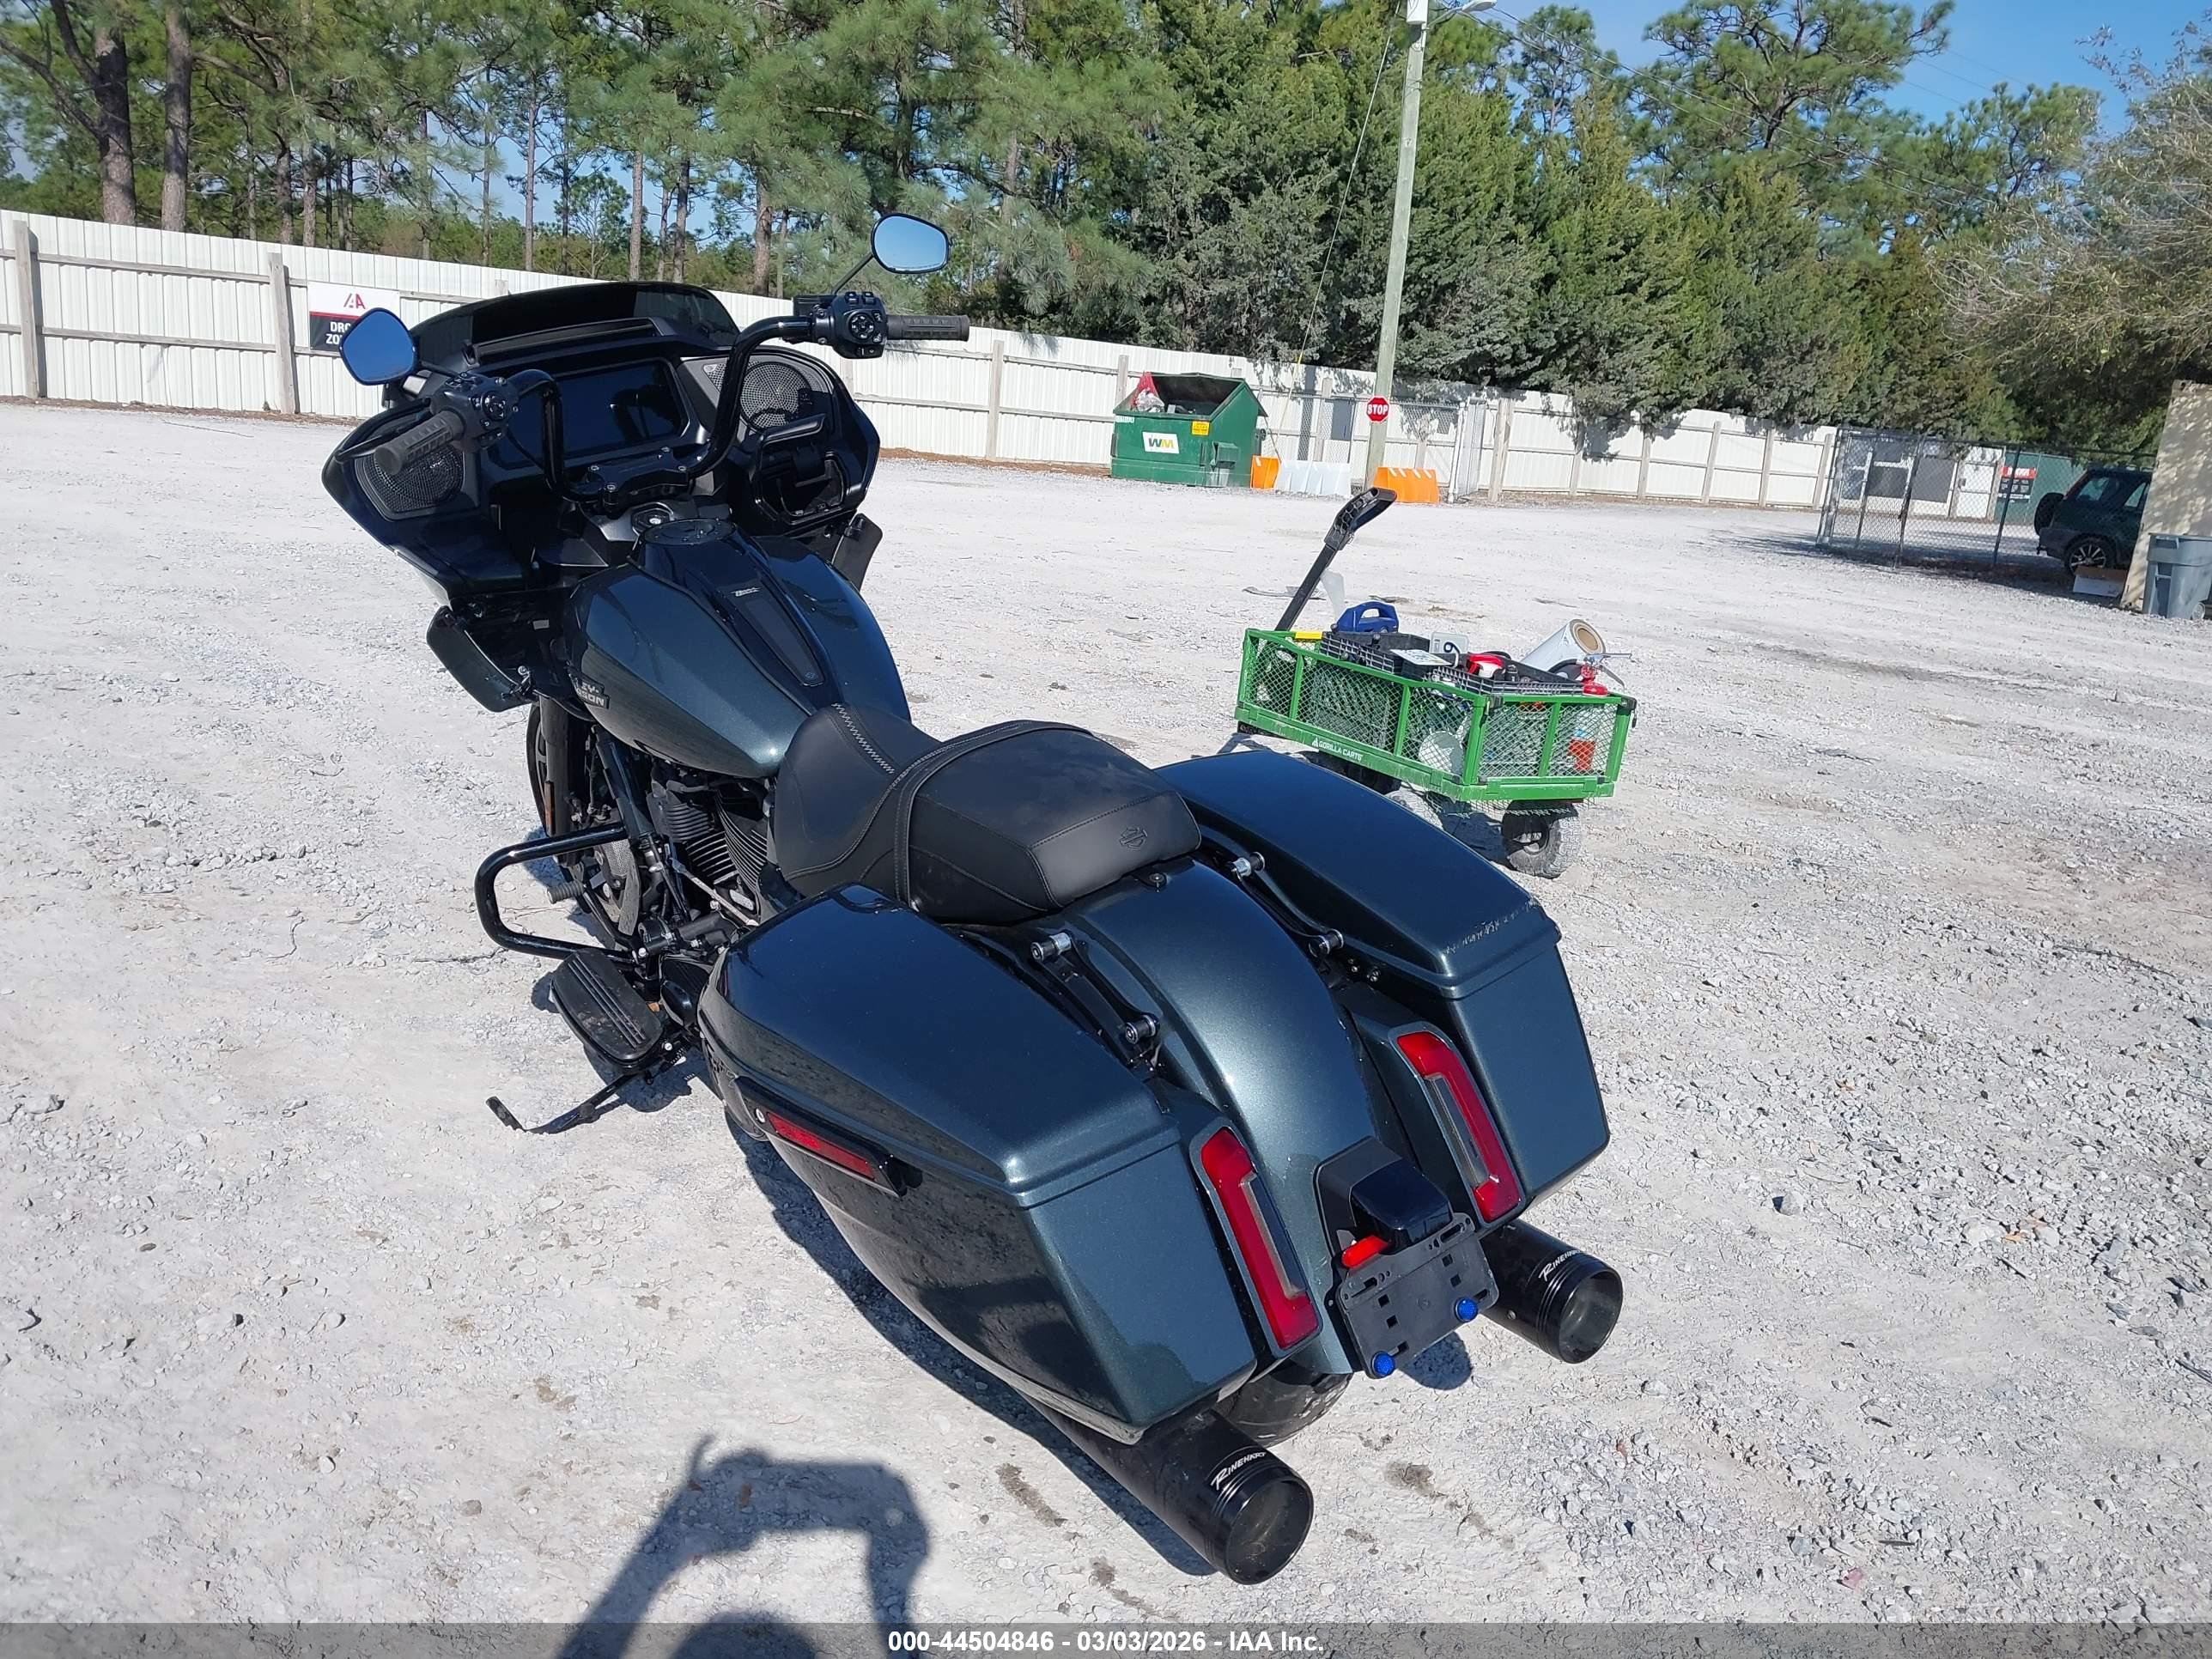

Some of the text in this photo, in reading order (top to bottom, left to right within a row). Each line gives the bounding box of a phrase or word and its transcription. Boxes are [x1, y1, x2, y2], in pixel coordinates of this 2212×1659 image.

[330, 321, 351, 333] DRO
[325, 333, 343, 345] ZO
[1367, 404, 1389, 416] STOP
[1148, 438, 1175, 449] WM
[1318, 740, 1342, 754] GORILLA
[1210, 1451, 1267, 1491] RINEHART
